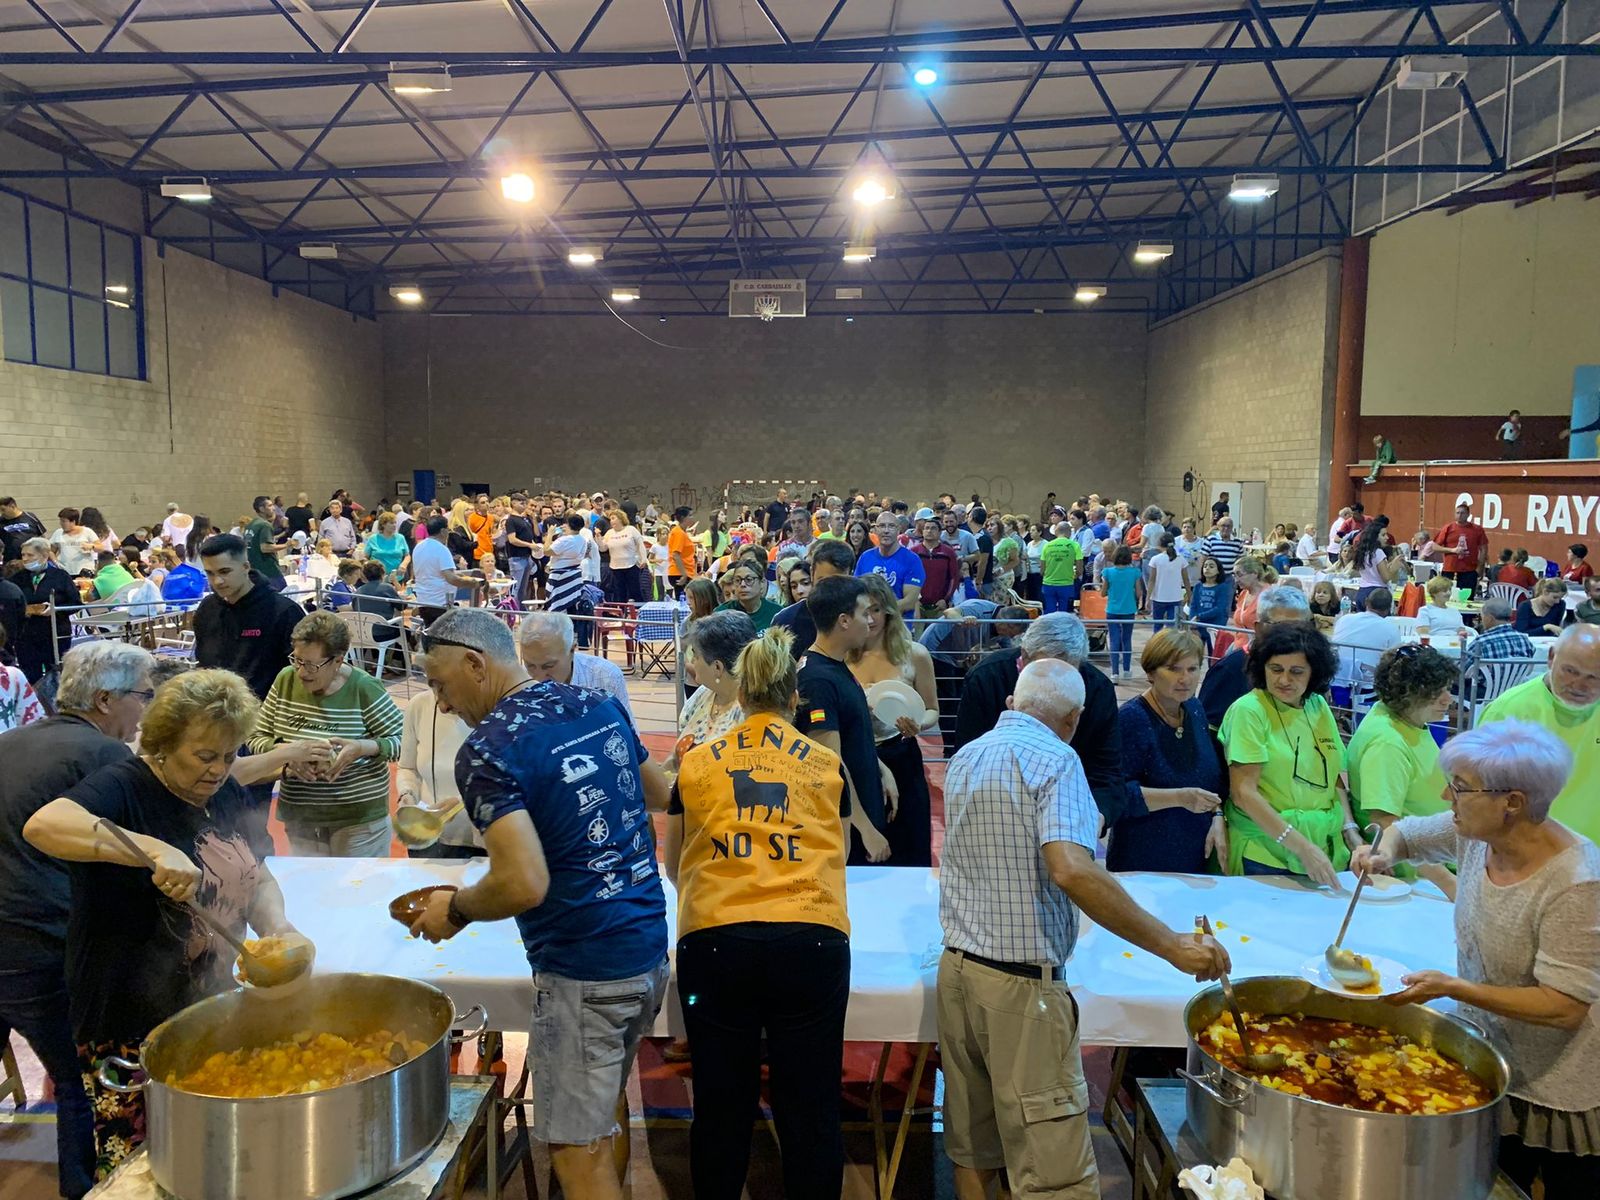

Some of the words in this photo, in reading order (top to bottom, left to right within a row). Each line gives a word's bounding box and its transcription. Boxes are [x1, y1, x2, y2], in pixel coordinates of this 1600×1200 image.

[709, 723, 812, 762] PEÑA
[711, 832, 752, 861] NO
[768, 824, 804, 862] SÉ
